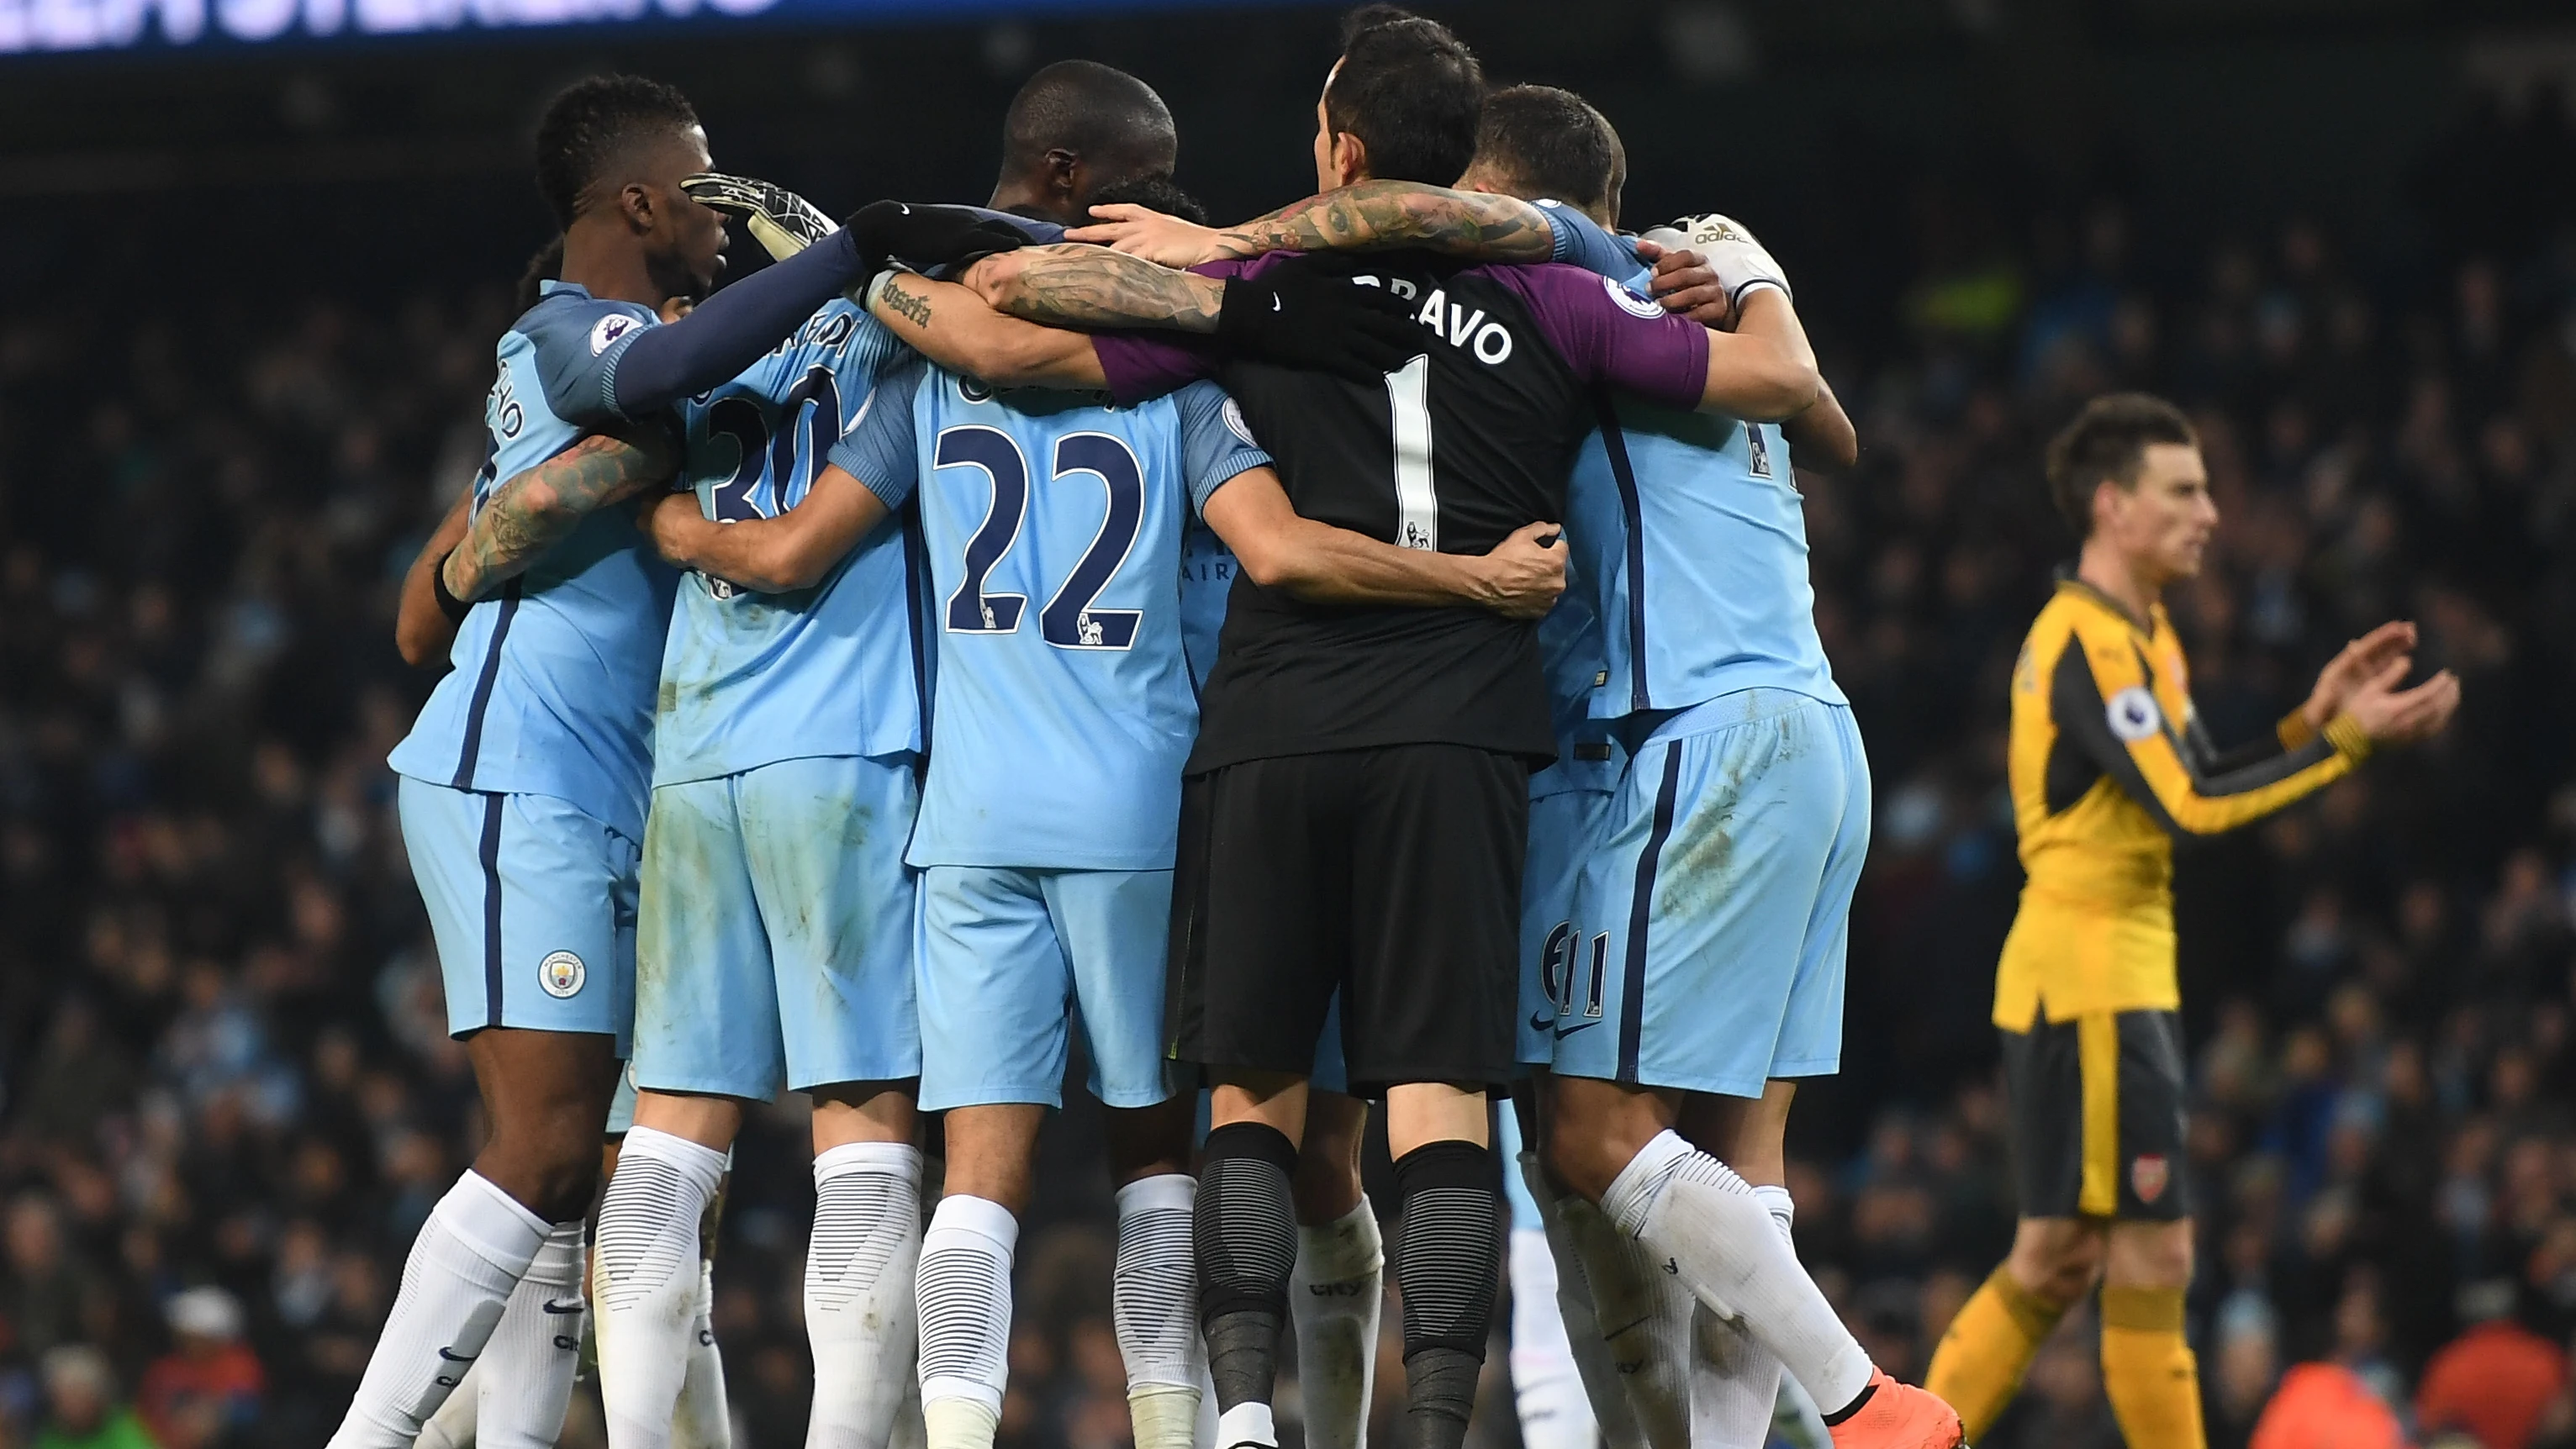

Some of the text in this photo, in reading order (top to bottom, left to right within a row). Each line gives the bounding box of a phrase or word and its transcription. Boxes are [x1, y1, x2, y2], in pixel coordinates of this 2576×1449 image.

[932, 424, 1146, 651] 22
[1383, 353, 1438, 553] 1
[1558, 929, 1610, 1018] 11
